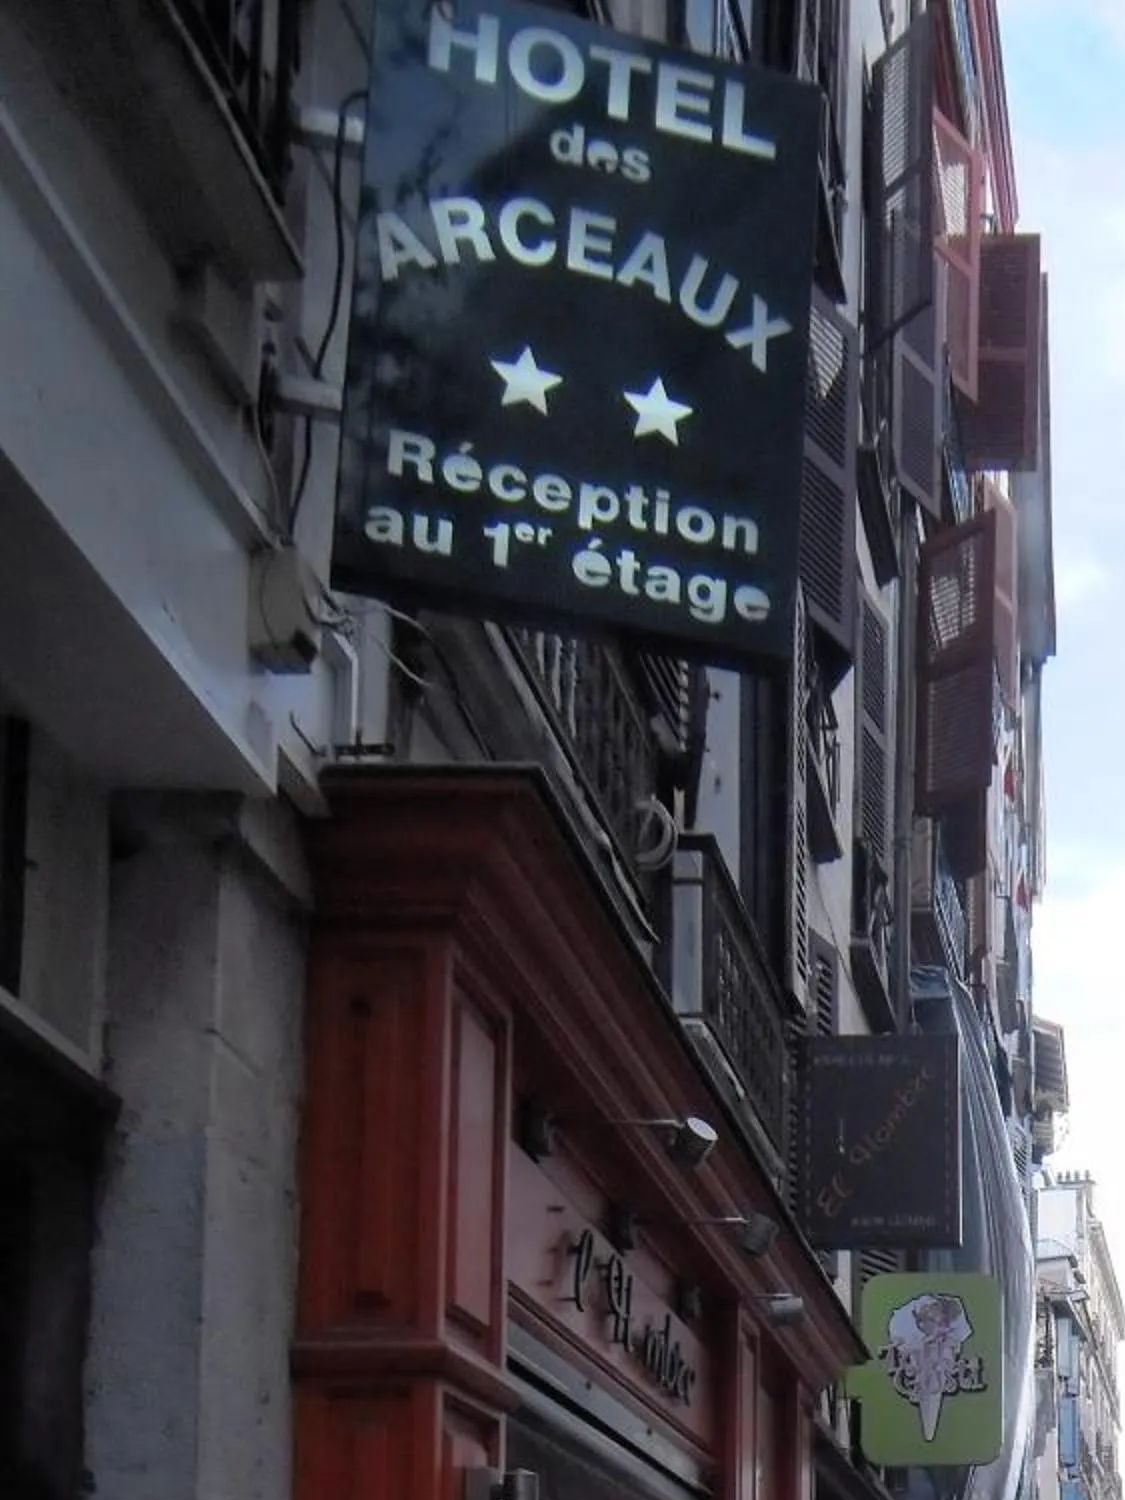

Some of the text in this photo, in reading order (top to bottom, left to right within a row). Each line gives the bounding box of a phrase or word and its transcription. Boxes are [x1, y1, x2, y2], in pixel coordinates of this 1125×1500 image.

[427, 5, 776, 160] HOTEL
[549, 124, 653, 183] des
[376, 196, 794, 374] ARCEAUX
[387, 429, 759, 555] Réception
[364, 505, 454, 558] au
[572, 538, 772, 624] étage
